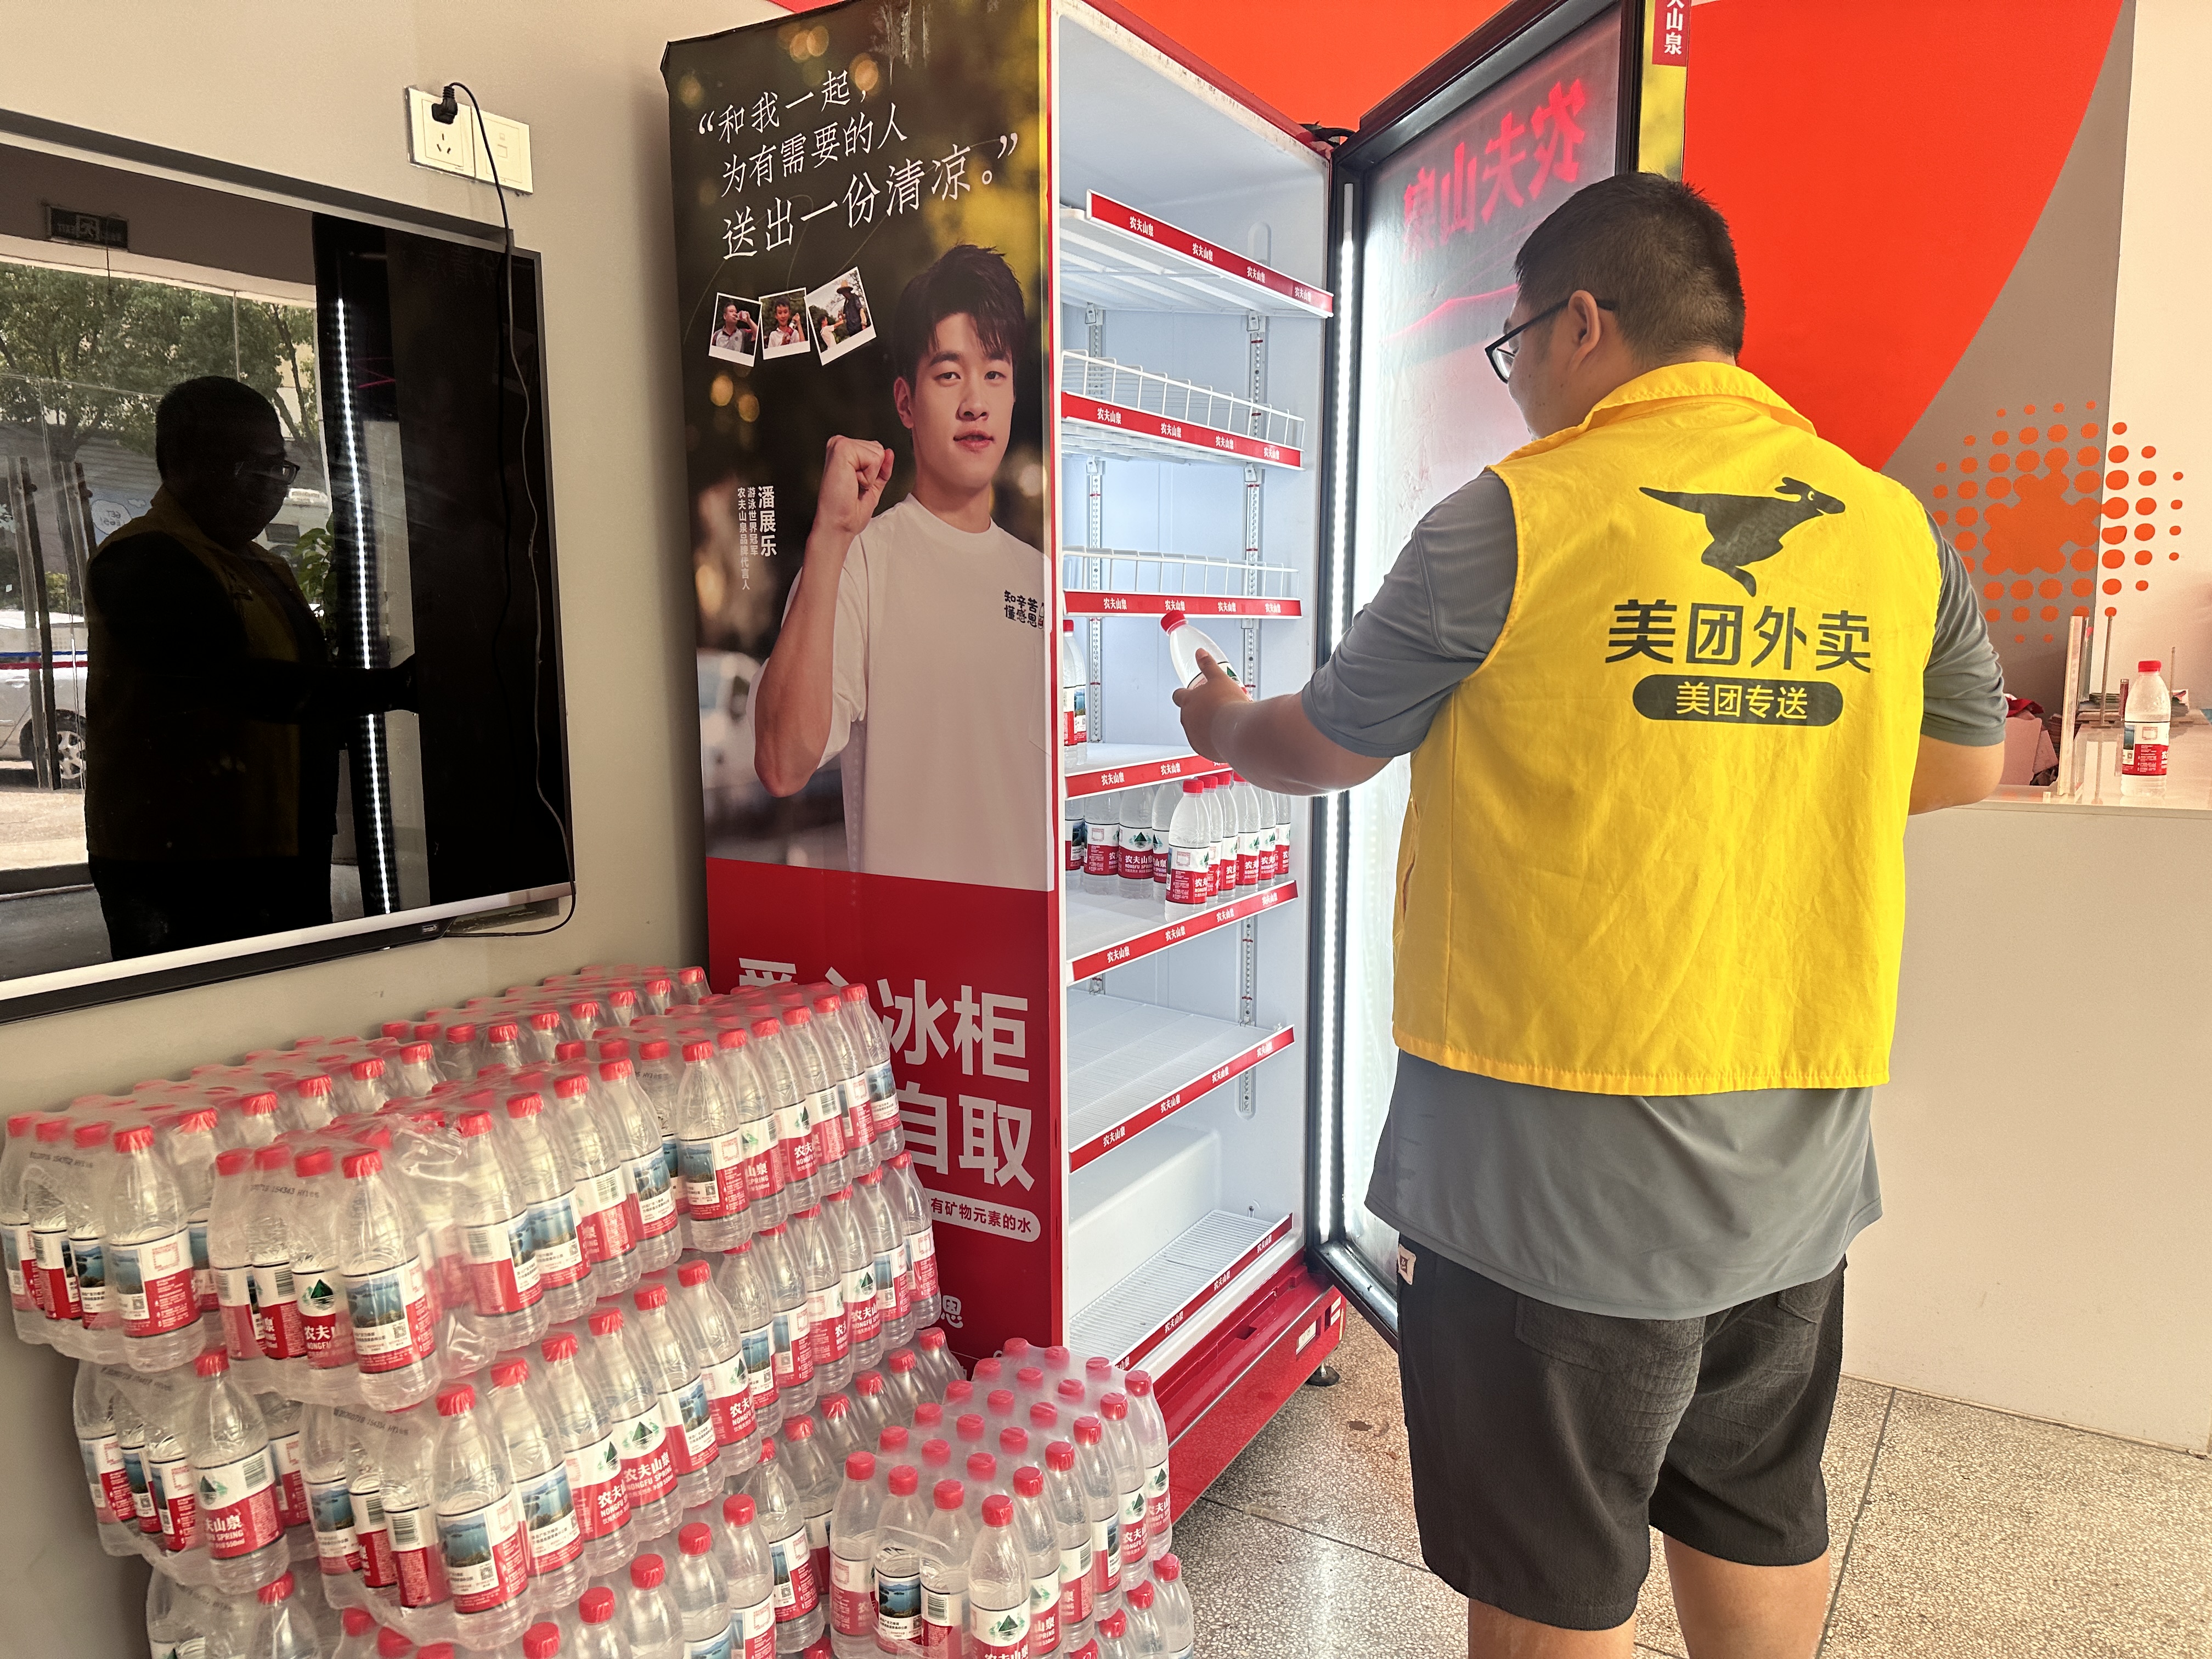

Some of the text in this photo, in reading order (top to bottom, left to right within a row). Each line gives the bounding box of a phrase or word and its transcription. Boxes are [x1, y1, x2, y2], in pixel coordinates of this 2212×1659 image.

[721, 103, 908, 197] 为有需要的人
[1129, 216, 1312, 303] 农夫山泉 农夫山泉 农夫山泉 农夫山泉
[1097, 408, 1280, 460] 农夫山泉 农夫山泉 农夫山泉 农夫山泉
[737, 487, 751, 590] 农夫山泉品牌代言人
[747, 486, 759, 556] 游泳世界冠军
[758, 485, 777, 557] 潘展乐
[1003, 589, 1039, 613] 知辛苦
[1003, 603, 1038, 628] 懂感恩
[1103, 597, 1282, 613] 农夫山泉 农夫山泉 农夫山泉 农夫山泉
[1605, 599, 1871, 673] 美团外卖
[1676, 681, 1808, 720] 美团专送
[1101, 763, 1181, 786] 农夫山泉 农夫山泉
[1107, 892, 1278, 963] 农夫山泉 农夫山泉 农夫山泉 农夫山泉
[739, 957, 1029, 1082] 冰柜
[1103, 1041, 1273, 1147] 农夫山泉 农夫山泉 农夫山泉 农夫山泉
[931, 1198, 1031, 1233] 有矿物元素的水
[1165, 1311, 1183, 1334] 农夫山泉
[1214, 1271, 1231, 1291] 农夫山泉
[1257, 1234, 1272, 1253] 农夫山泉
[623, 1452, 670, 1483] 农夫山泉
